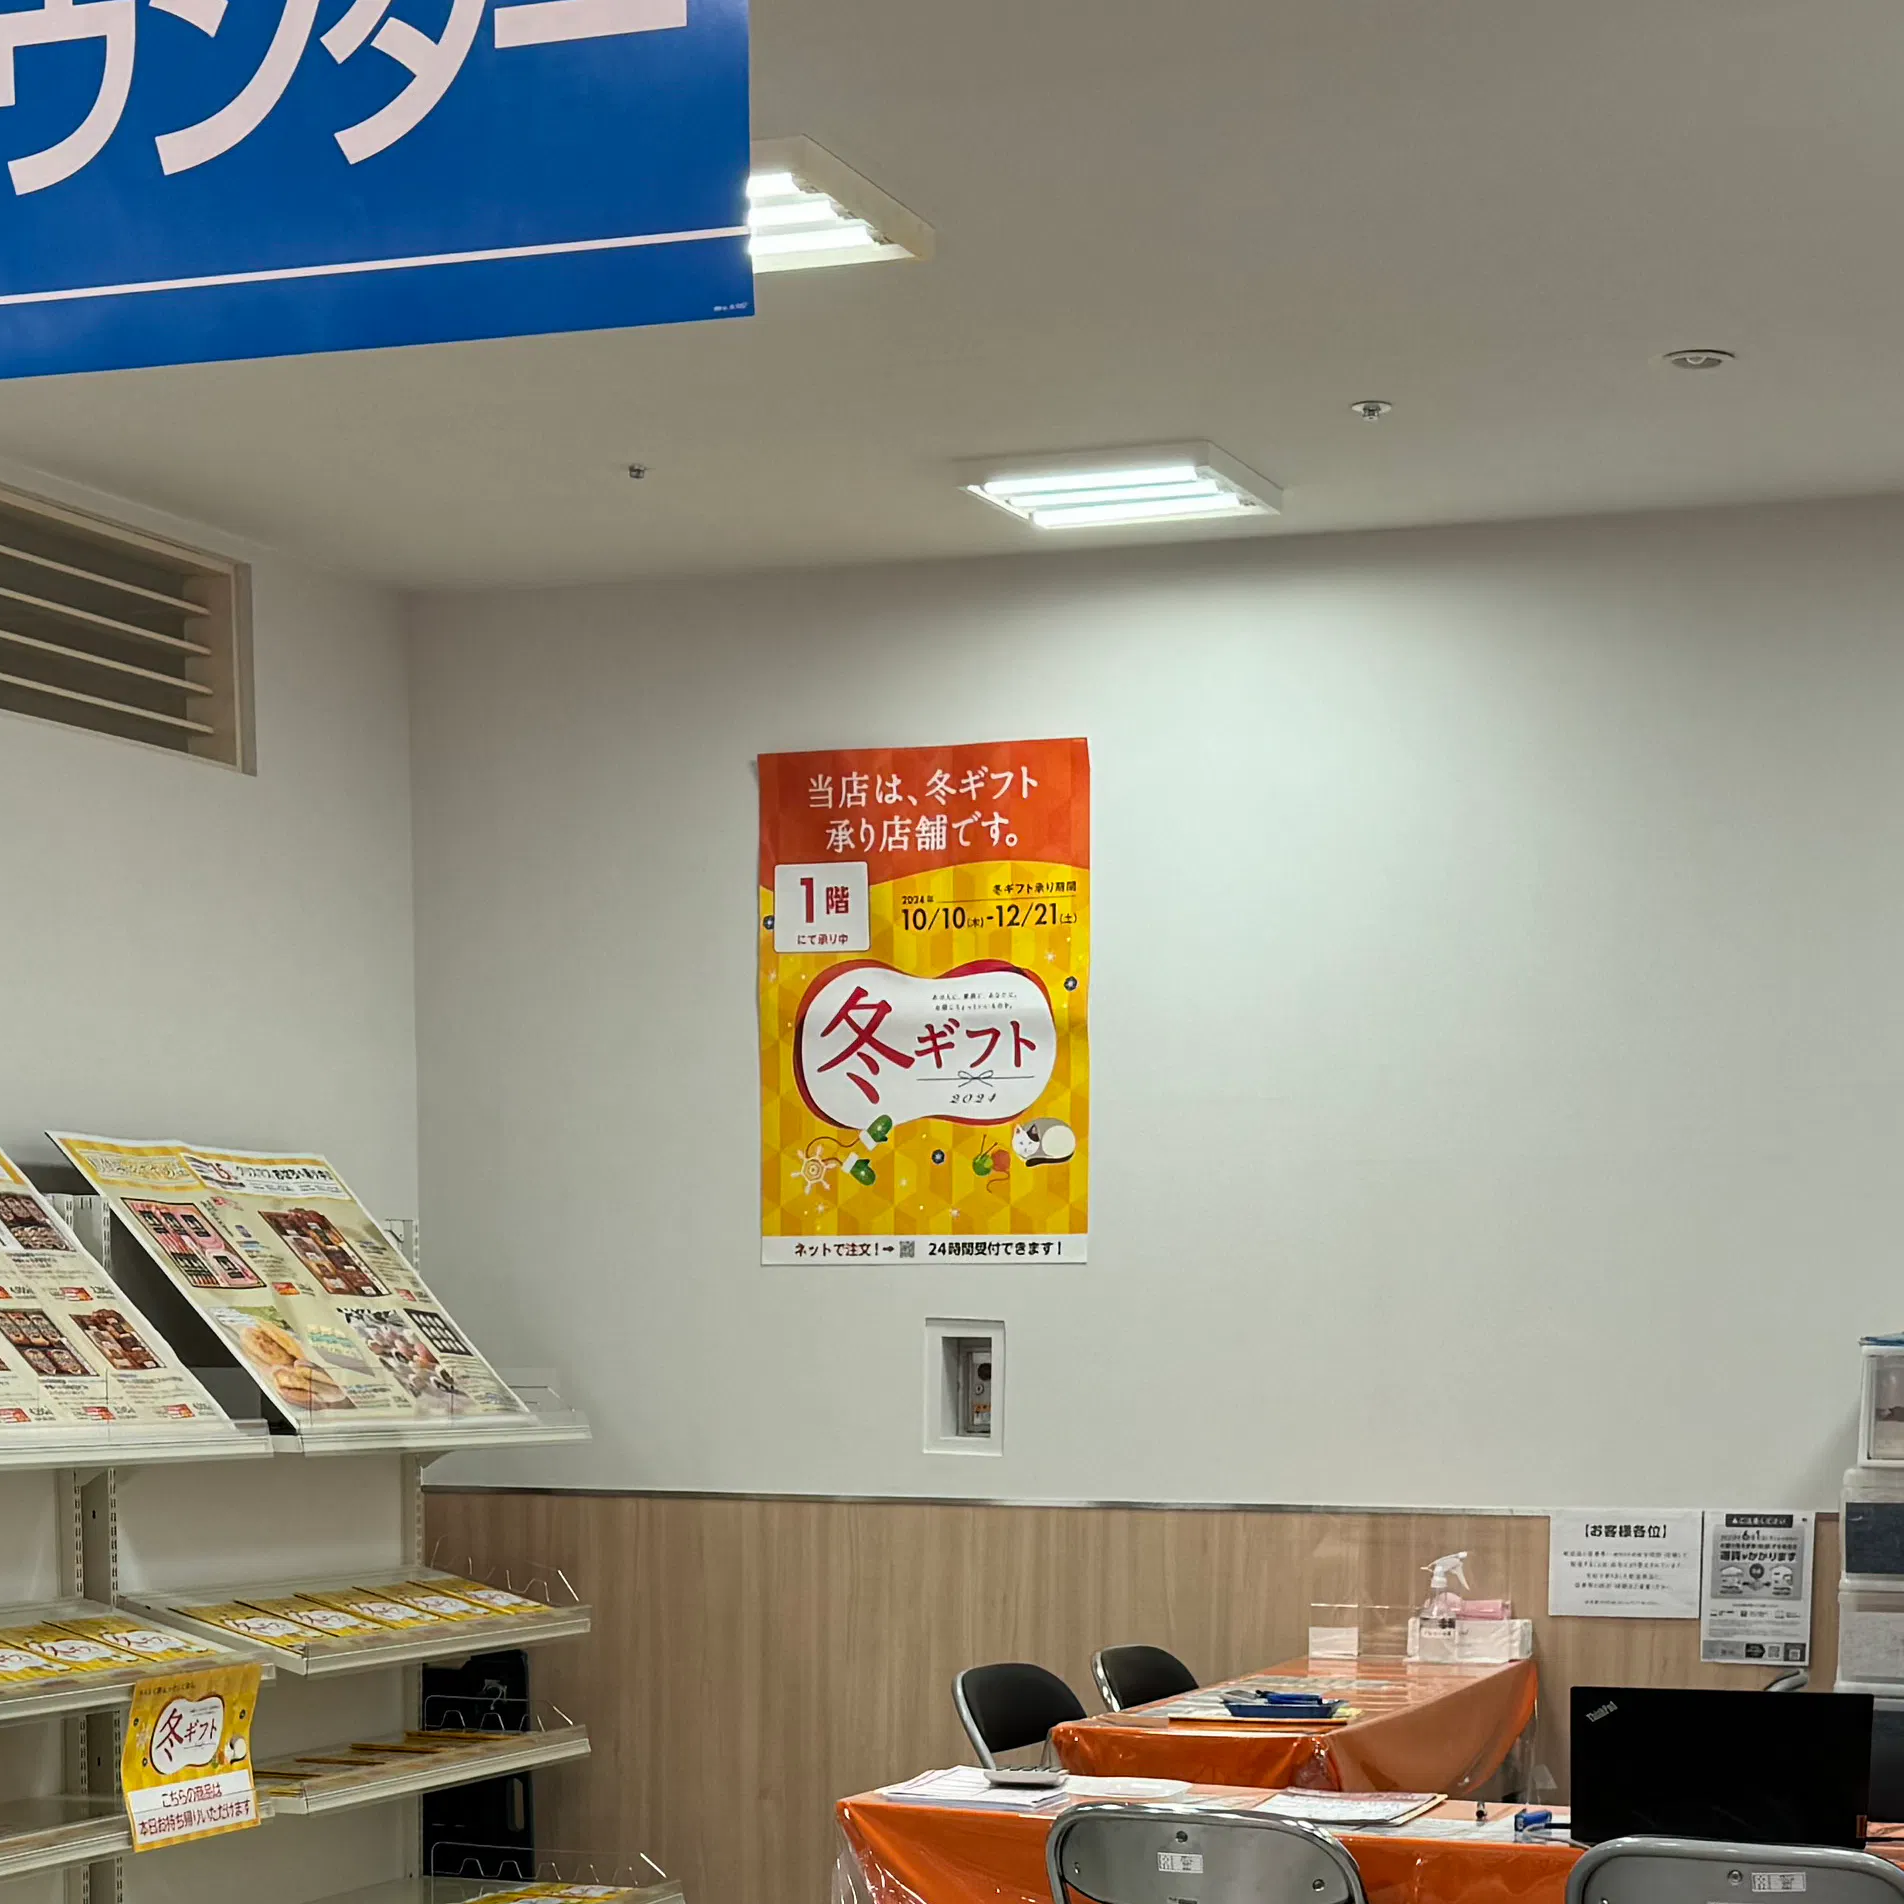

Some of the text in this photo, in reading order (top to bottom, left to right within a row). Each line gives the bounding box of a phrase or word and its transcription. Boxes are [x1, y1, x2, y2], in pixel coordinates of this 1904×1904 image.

[808, 767, 1039, 810] 当店は、冬ギフト
[825, 812, 1019, 852] 承り店舗です。
[799, 877, 849, 924] 1階
[993, 882, 1077, 896] 冬ギフト承り期間
[797, 933, 848, 946] にて承り中
[817, 985, 1037, 1105] 冬ギフト
[155, 1708, 218, 1762] 冬ギフト
